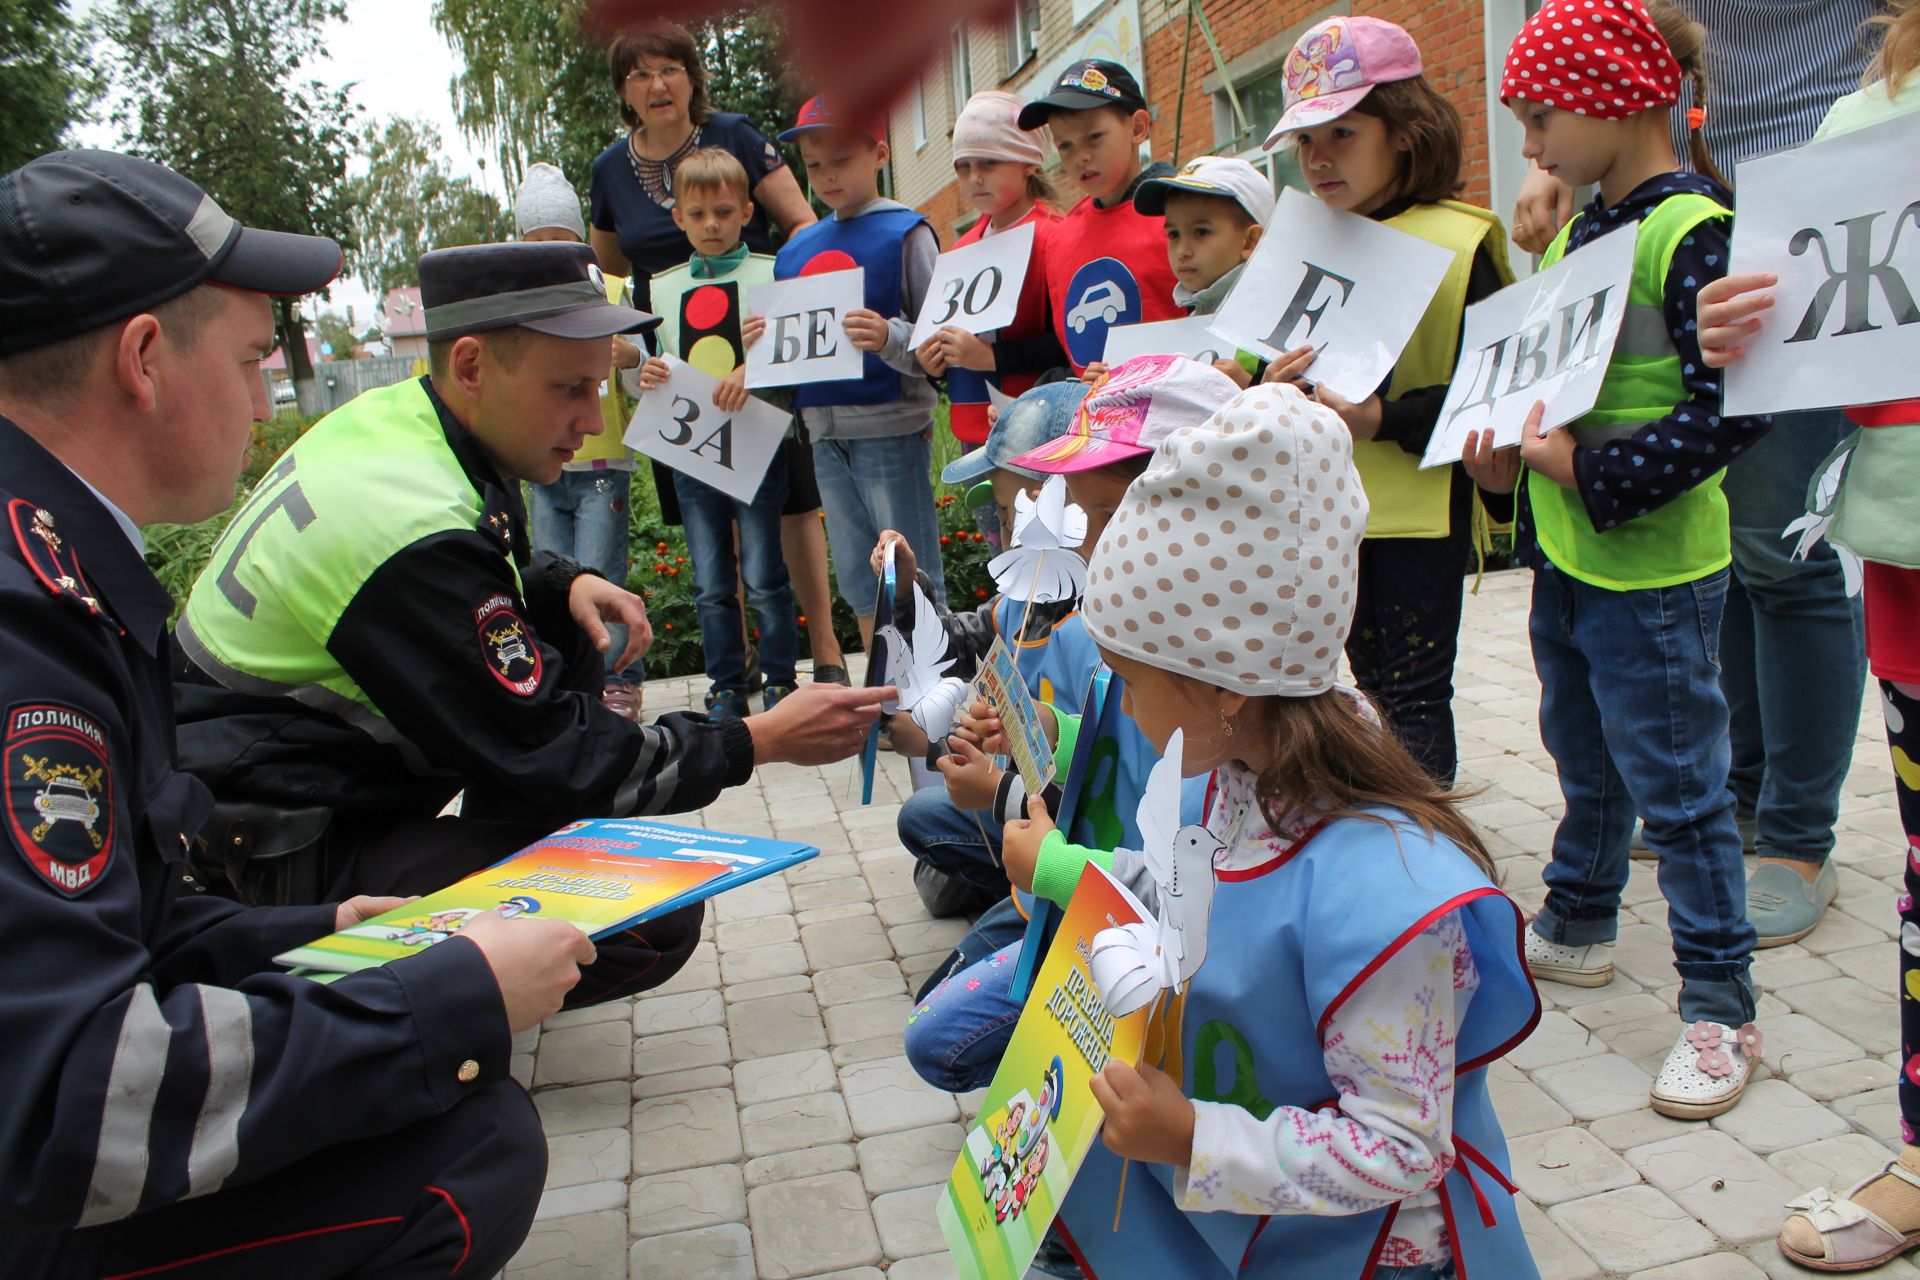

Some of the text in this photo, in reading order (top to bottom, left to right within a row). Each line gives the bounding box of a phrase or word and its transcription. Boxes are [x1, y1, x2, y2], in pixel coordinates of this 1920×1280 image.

[932, 266, 1002, 325] ЗО
[1784, 200, 1920, 343] Ж
[769, 307, 838, 365] БЕ
[1257, 261, 1355, 366] Е
[1448, 284, 1615, 428] ДВИ
[659, 394, 734, 471] ЗА
[478, 596, 512, 620] ПОЛИЦИЯ
[515, 676, 537, 693] МВД
[17, 711, 103, 746] ПОЛИЦИЯ
[50, 861, 91, 889] МВД
[489, 879, 634, 901] ДОРОЖНЫЕ
[522, 872, 632, 892] ПРАВИЛА
[1046, 984, 1111, 1073] ДОРОЖНЫ
[1064, 964, 1116, 1048] ПРАВИЛА
